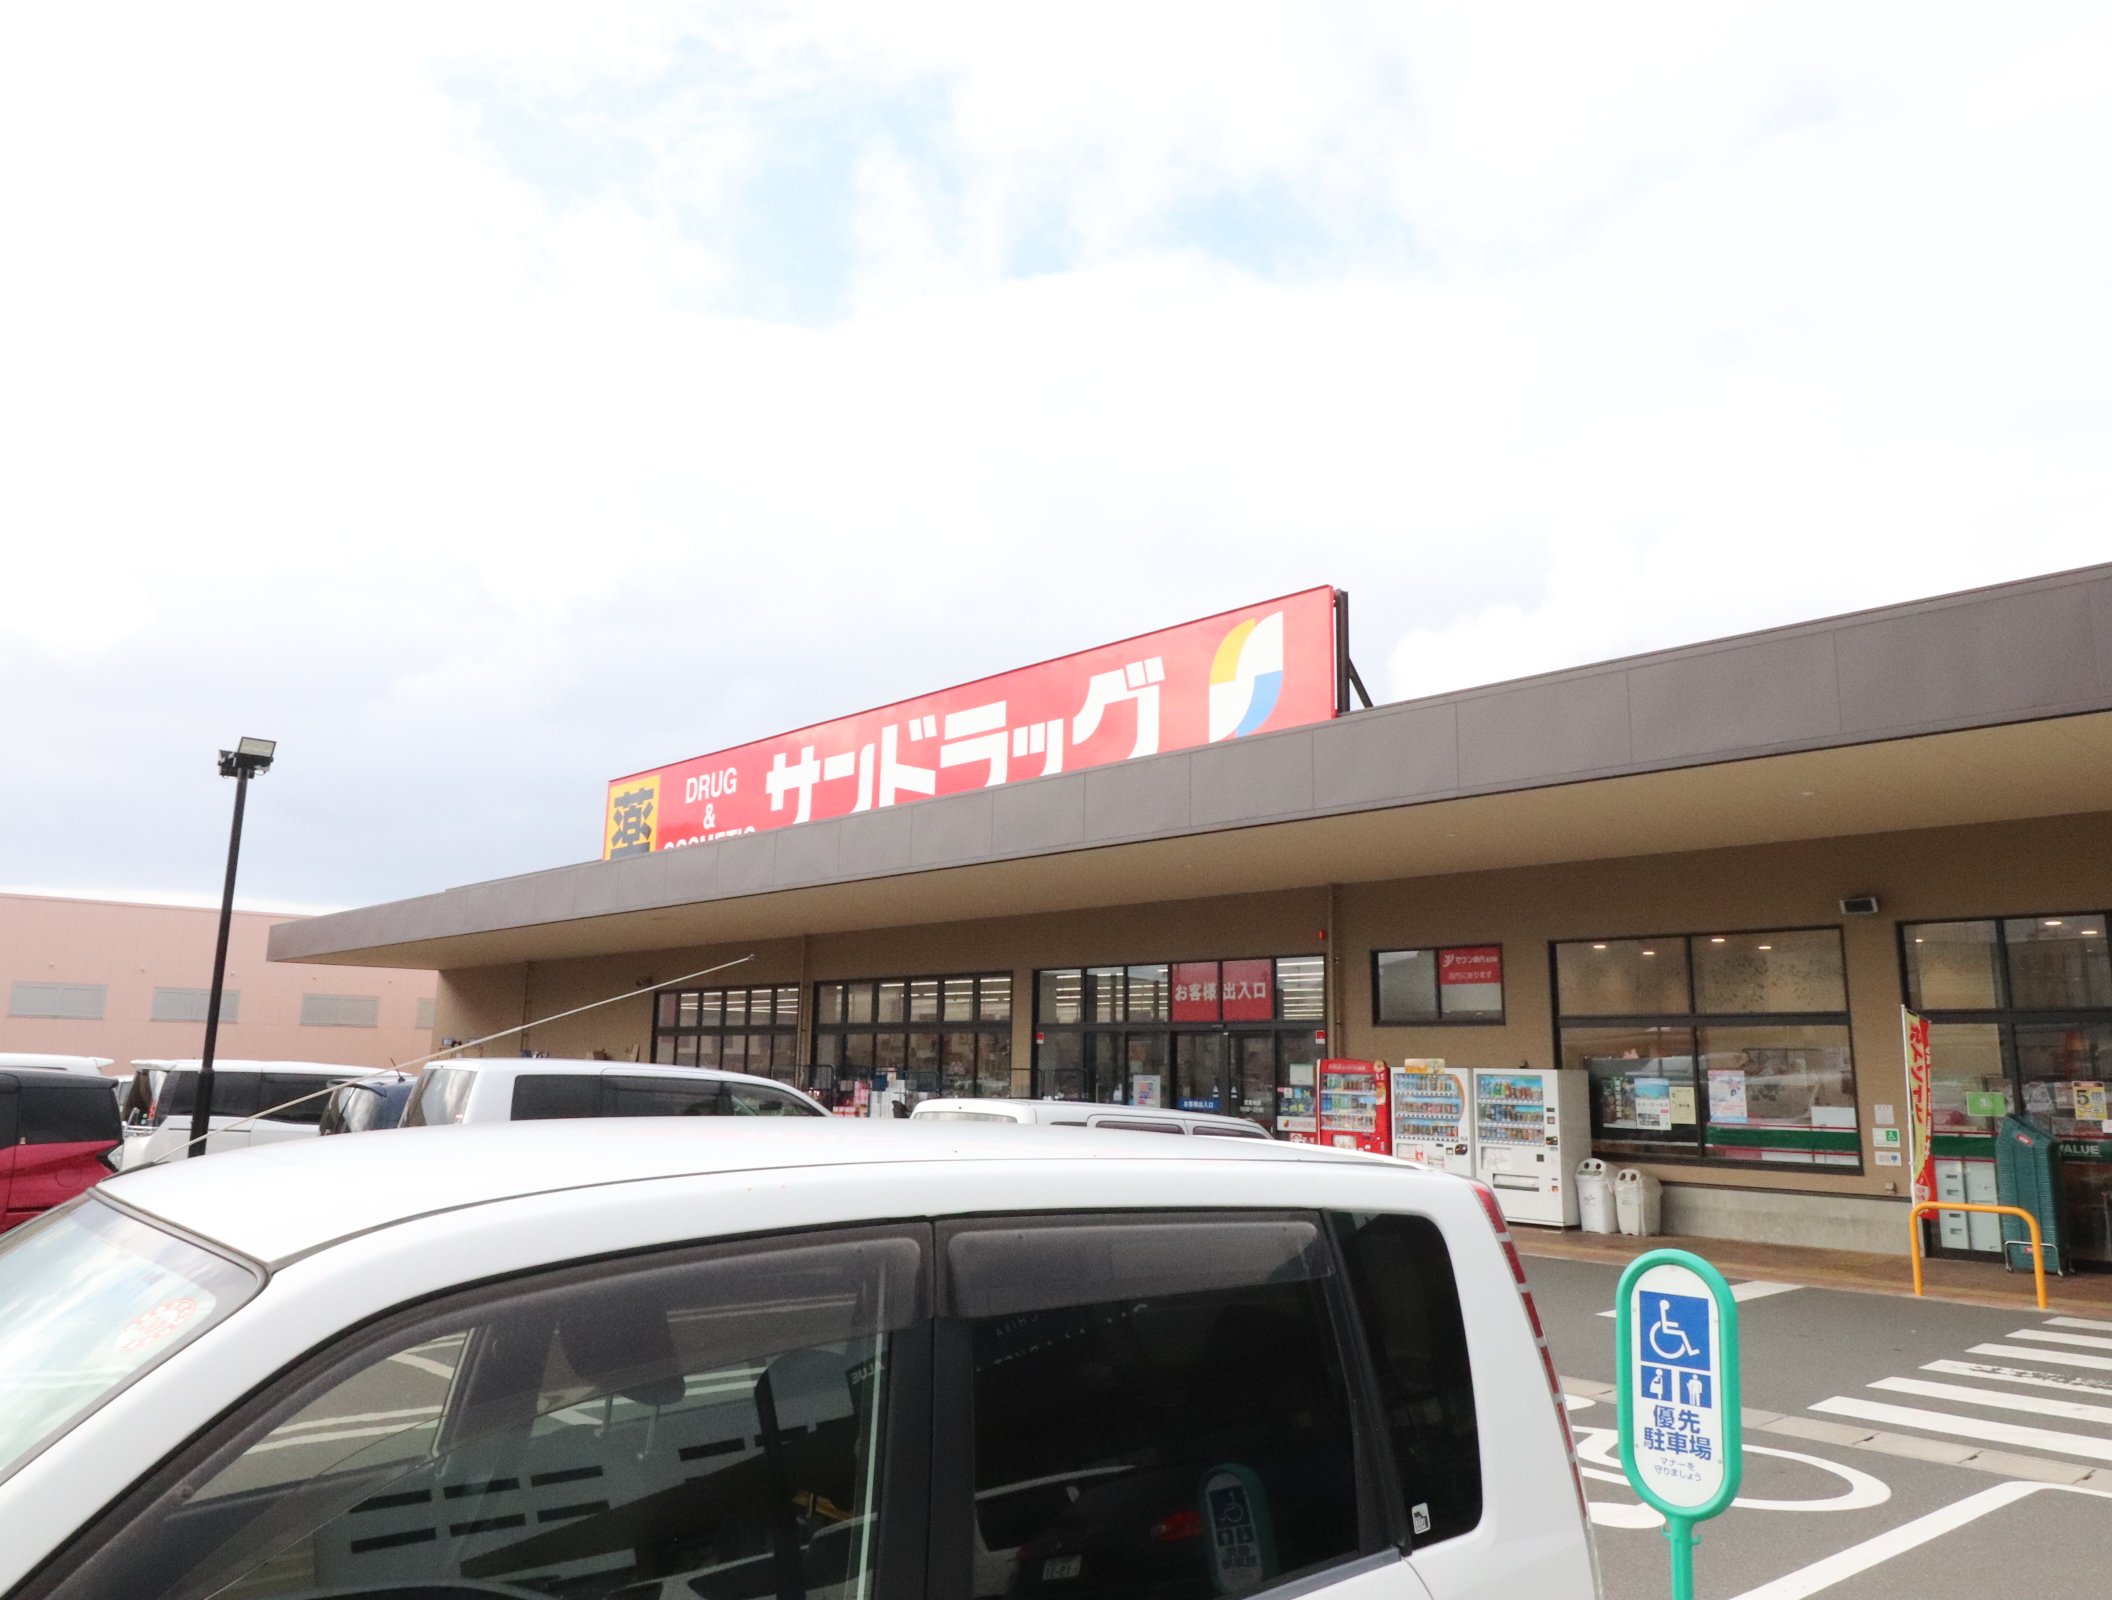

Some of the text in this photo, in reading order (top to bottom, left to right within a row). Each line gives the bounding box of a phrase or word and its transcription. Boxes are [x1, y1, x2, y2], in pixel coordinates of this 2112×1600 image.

[765, 655, 1164, 824] サンドラッグ
[685, 767, 738, 804] DRUG
[610, 787, 654, 859] 薬
[703, 803, 716, 830] &
[1653, 1405, 1701, 1434] 優先
[1644, 1427, 1712, 1461] 駐車場
[1654, 1465, 1702, 1482] 守りましょう
[1660, 1457, 1696, 1471] マナーを
